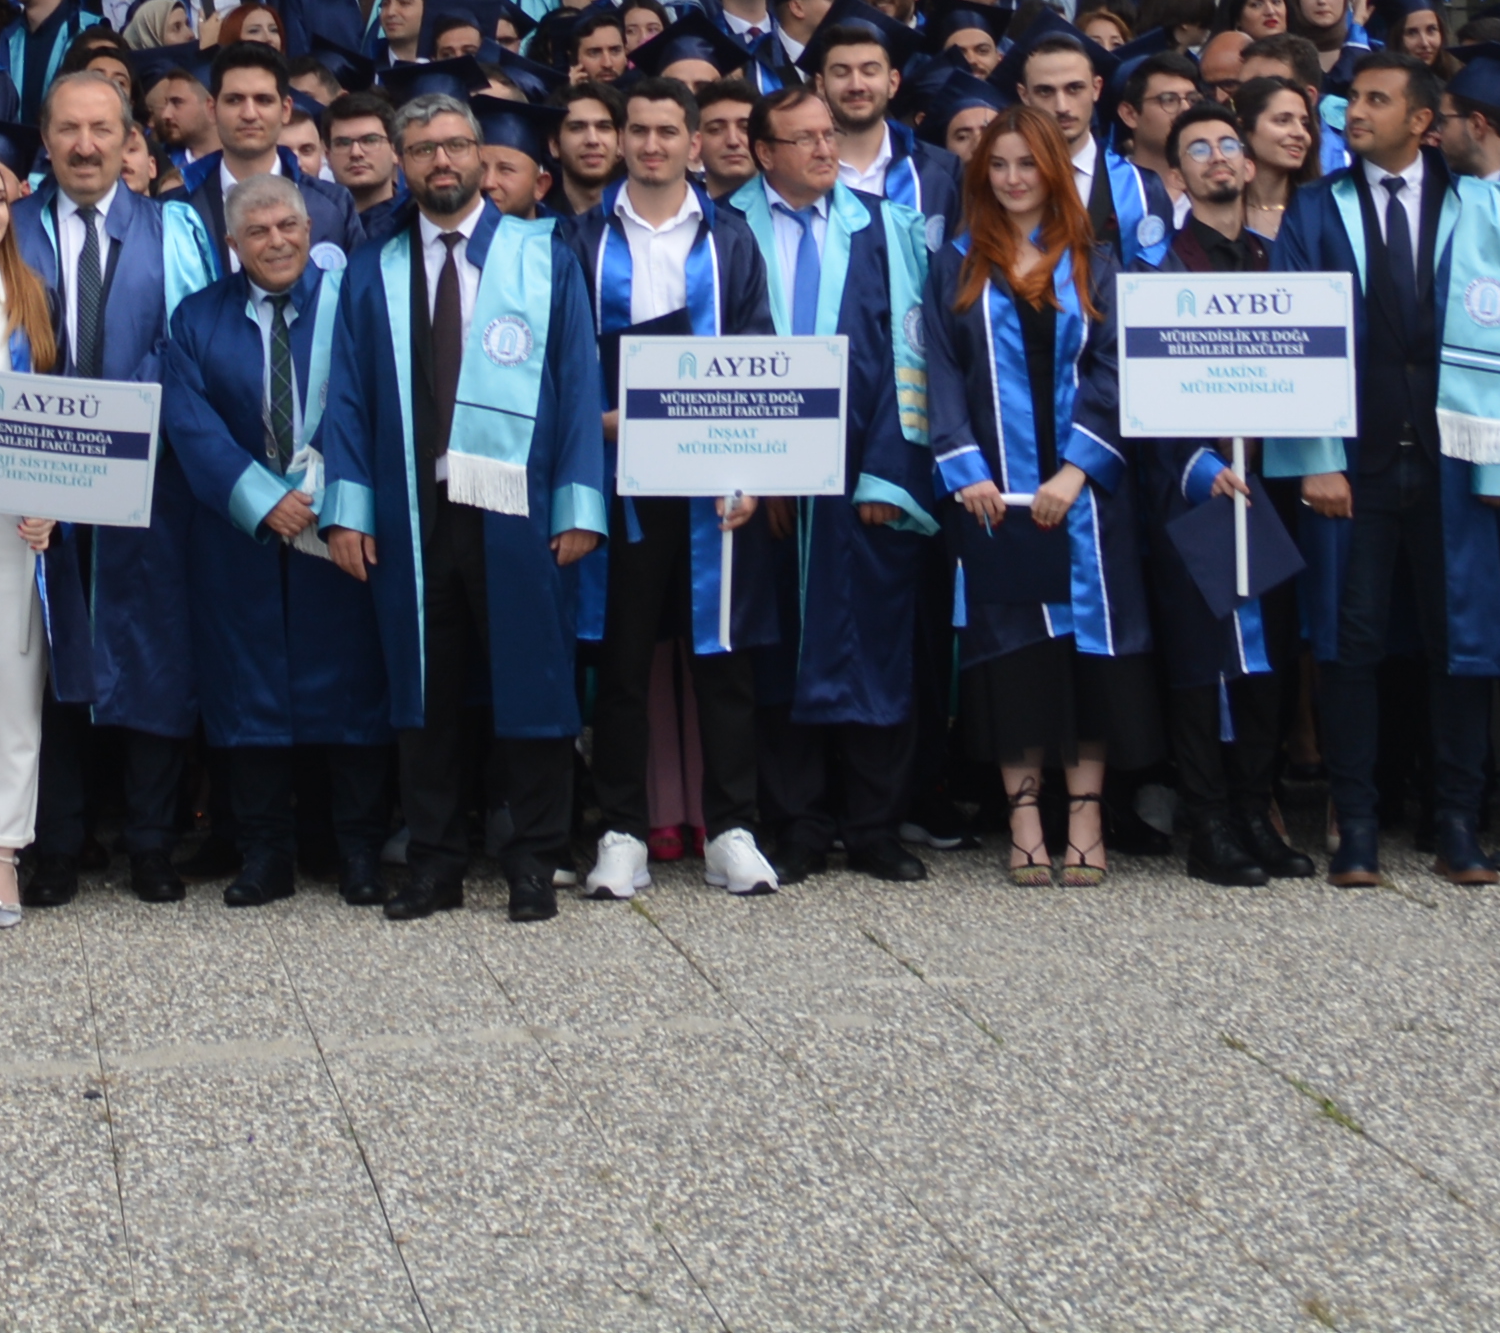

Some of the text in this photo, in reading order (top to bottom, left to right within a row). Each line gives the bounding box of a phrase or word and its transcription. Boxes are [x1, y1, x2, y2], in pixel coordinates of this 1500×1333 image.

[1204, 288, 1293, 315] AYBÜ
[1159, 328, 1310, 343] MÜHENDİSLİK VE DOĞA
[1168, 342, 1304, 356] BİLİMLERİ FAKÜLTESİ
[705, 352, 791, 377] AYBÜ
[1207, 364, 1267, 378] MAKİNE
[1180, 380, 1295, 394] MÜHENDİSLİĞİ
[660, 390, 805, 404] MÜHENDİSLİK VE DOĞA
[12, 393, 102, 418] AYBÜ
[668, 404, 799, 417] BİLİMLERİ FAKÜLTESİ
[57, 430, 74, 441] VE
[76, 432, 113, 444] DOĞA
[707, 425, 758, 440] İNŞAAT
[41, 439, 106, 456] FAKÜLTESİ
[677, 440, 788, 455] MÜHENDİSLİĞİ
[19, 455, 108, 476] SİSTEMLERİ
